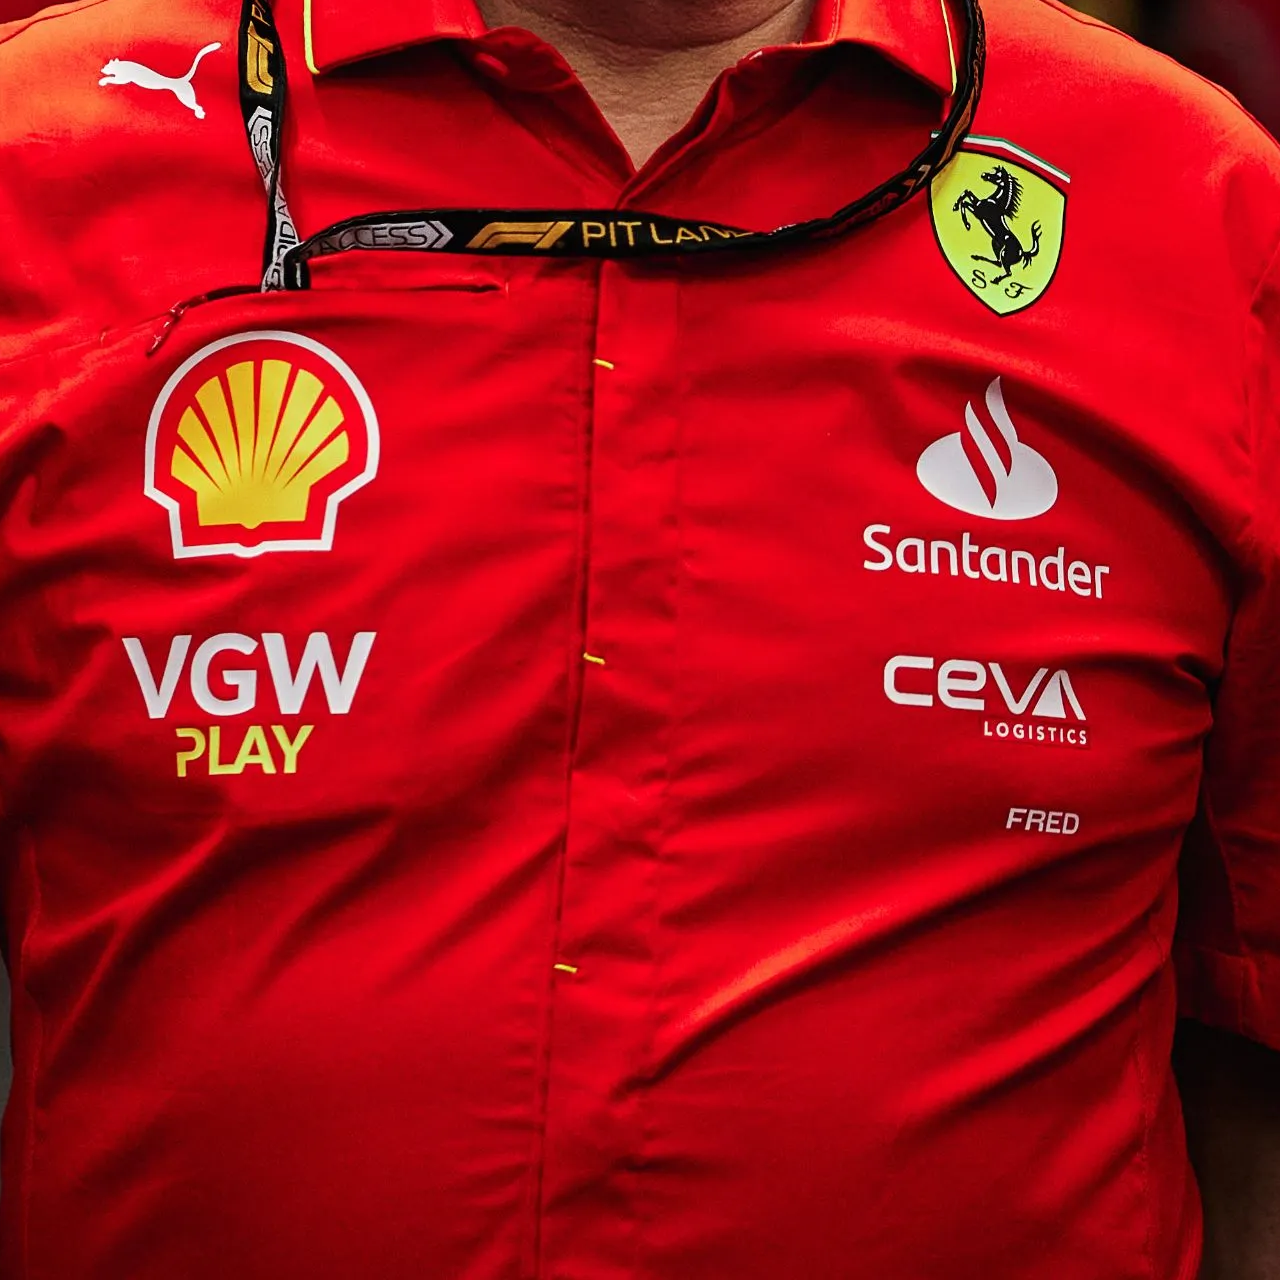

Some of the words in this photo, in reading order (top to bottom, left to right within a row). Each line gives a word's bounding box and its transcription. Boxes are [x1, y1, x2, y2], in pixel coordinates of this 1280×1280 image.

[320, 224, 428, 254] ACCESS
[581, 221, 642, 248] PIT
[863, 523, 1110, 599] Santander
[121, 631, 377, 719] VGW
[175, 724, 314, 778] PLAY
[983, 720, 1088, 746] LOGISTICS
[1005, 807, 1080, 836] FRED
